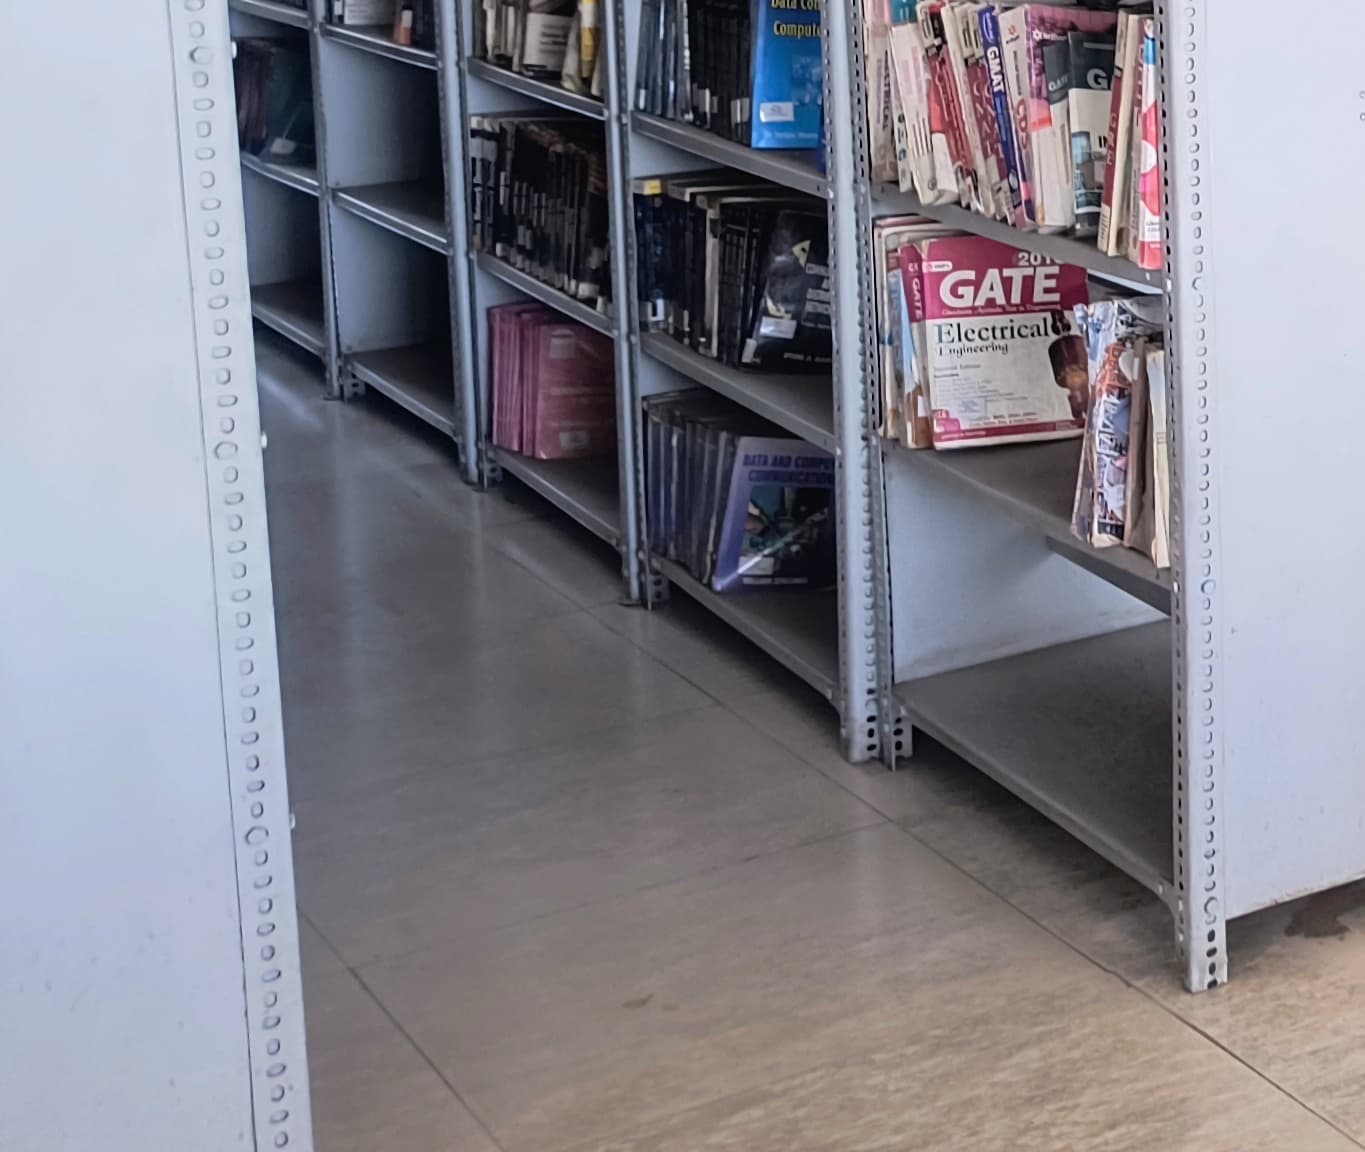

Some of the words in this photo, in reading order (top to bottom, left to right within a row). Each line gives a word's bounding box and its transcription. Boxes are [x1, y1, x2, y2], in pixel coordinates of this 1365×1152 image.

[986, 46, 1004, 93] GMAT
[1018, 252, 1064, 266] 201
[911, 277, 923, 321] GATE
[939, 266, 1061, 309] GATE
[935, 317, 1050, 345] Electrical
[938, 342, 1009, 359] Engineering
